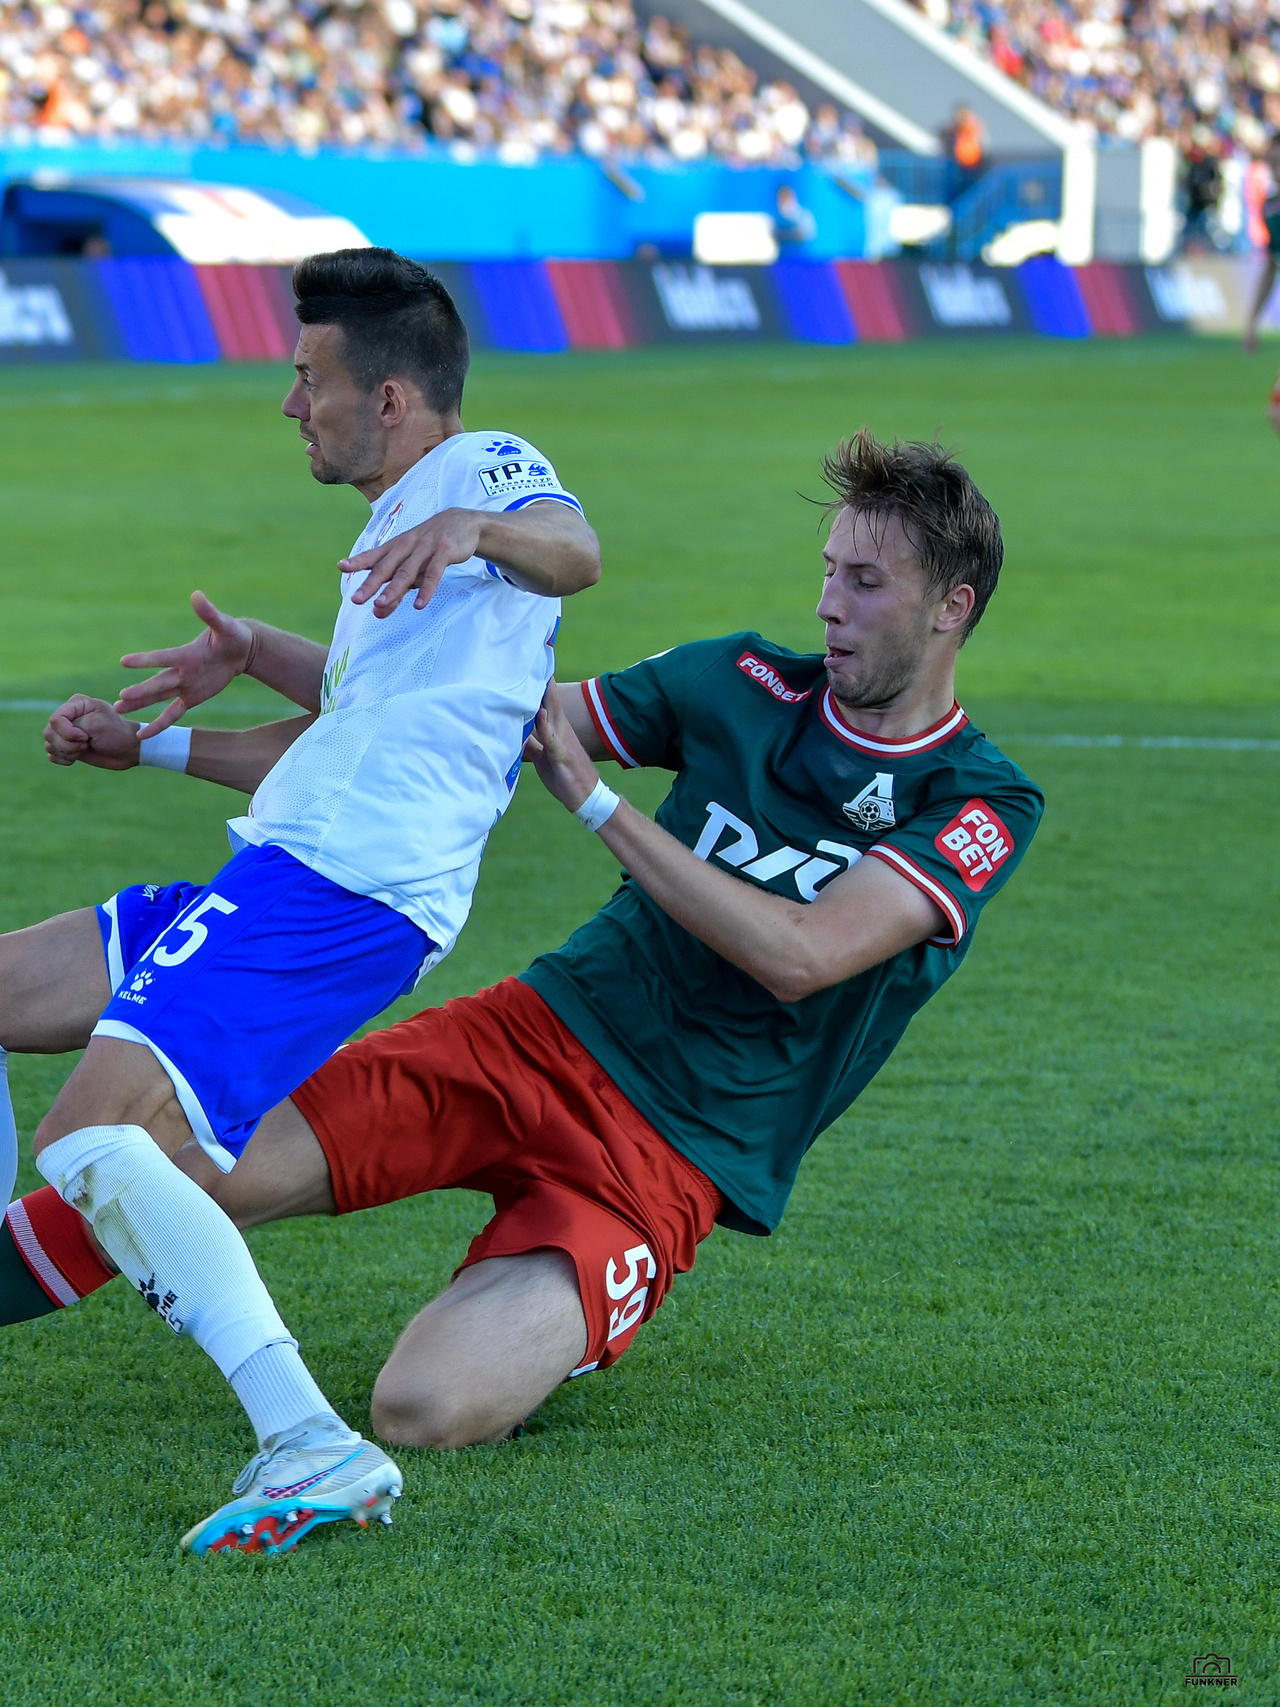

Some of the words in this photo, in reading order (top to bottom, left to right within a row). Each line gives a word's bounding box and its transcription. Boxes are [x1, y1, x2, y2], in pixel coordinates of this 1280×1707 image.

[740, 657, 809, 702] FONBET
[941, 826, 993, 877] BET
[960, 808, 1009, 862] FON
[118, 990, 147, 1005] KELME
[605, 1243, 657, 1342] 59
